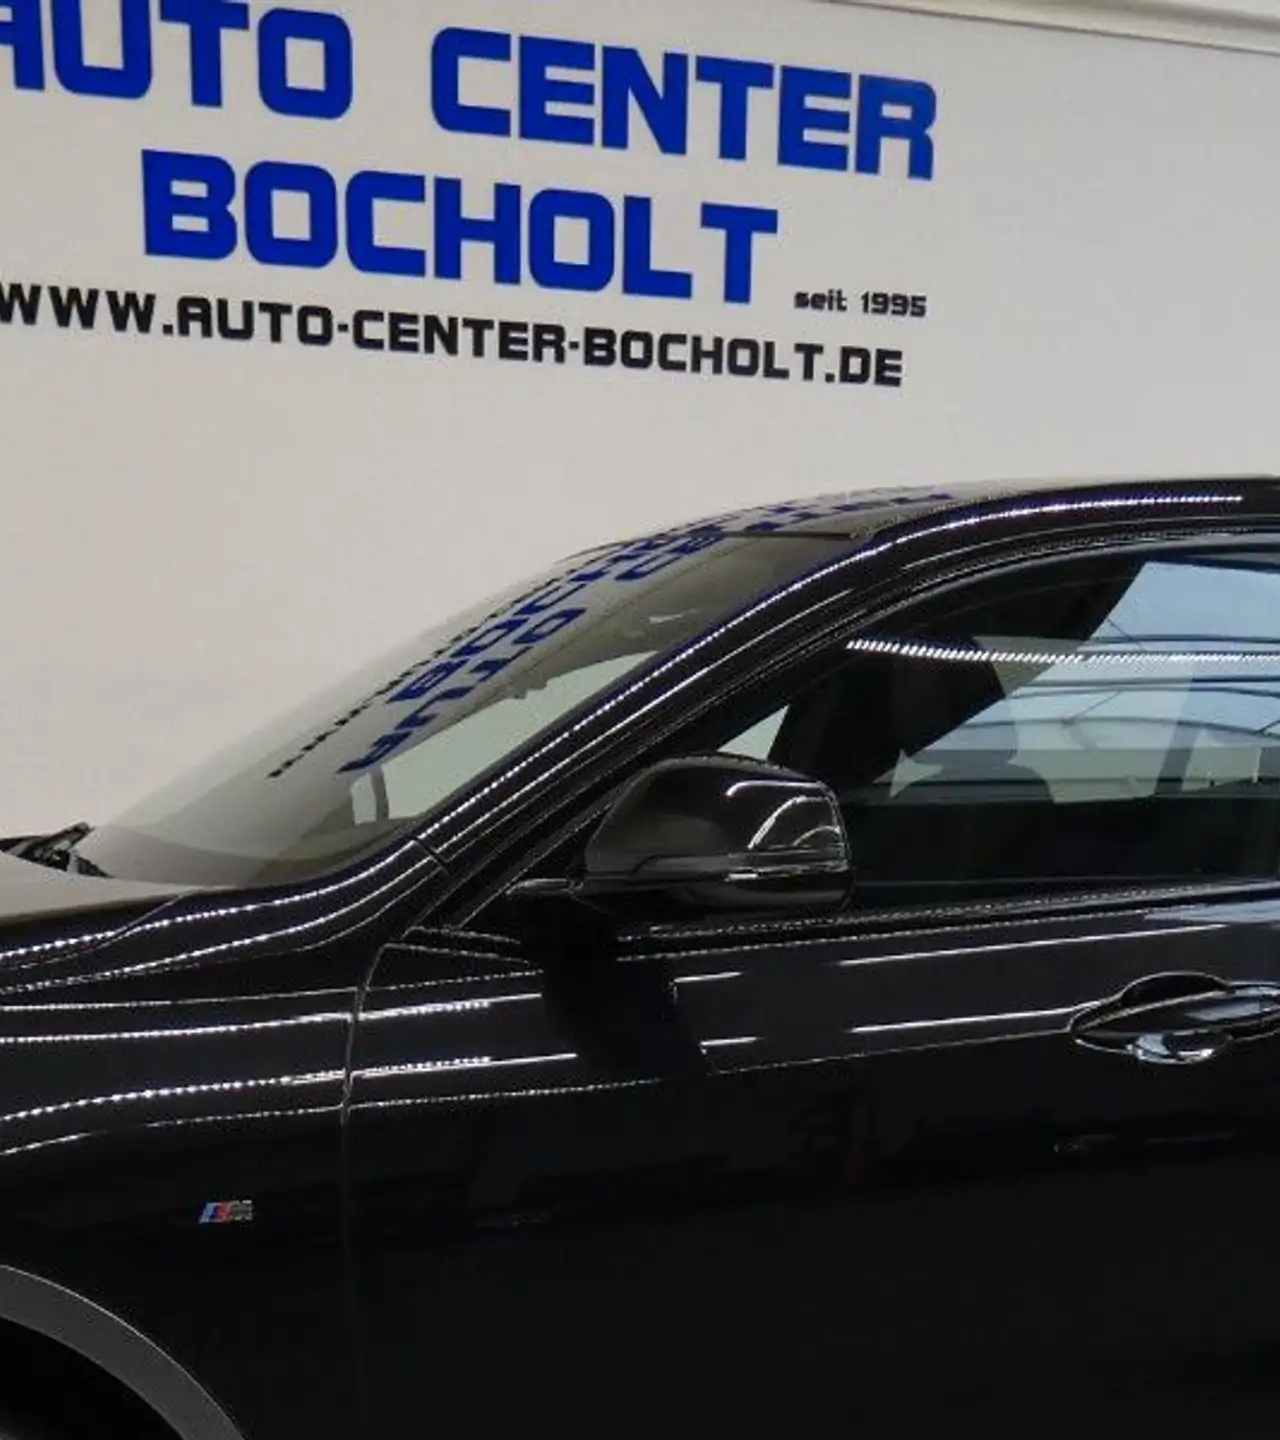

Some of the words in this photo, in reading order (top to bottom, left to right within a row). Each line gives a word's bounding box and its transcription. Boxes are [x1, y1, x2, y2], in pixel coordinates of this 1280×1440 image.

[431, 27, 937, 180] CENTER
[141, 149, 779, 304] BOCHOLT
[794, 289, 848, 312] seit
[861, 291, 927, 317] 1995
